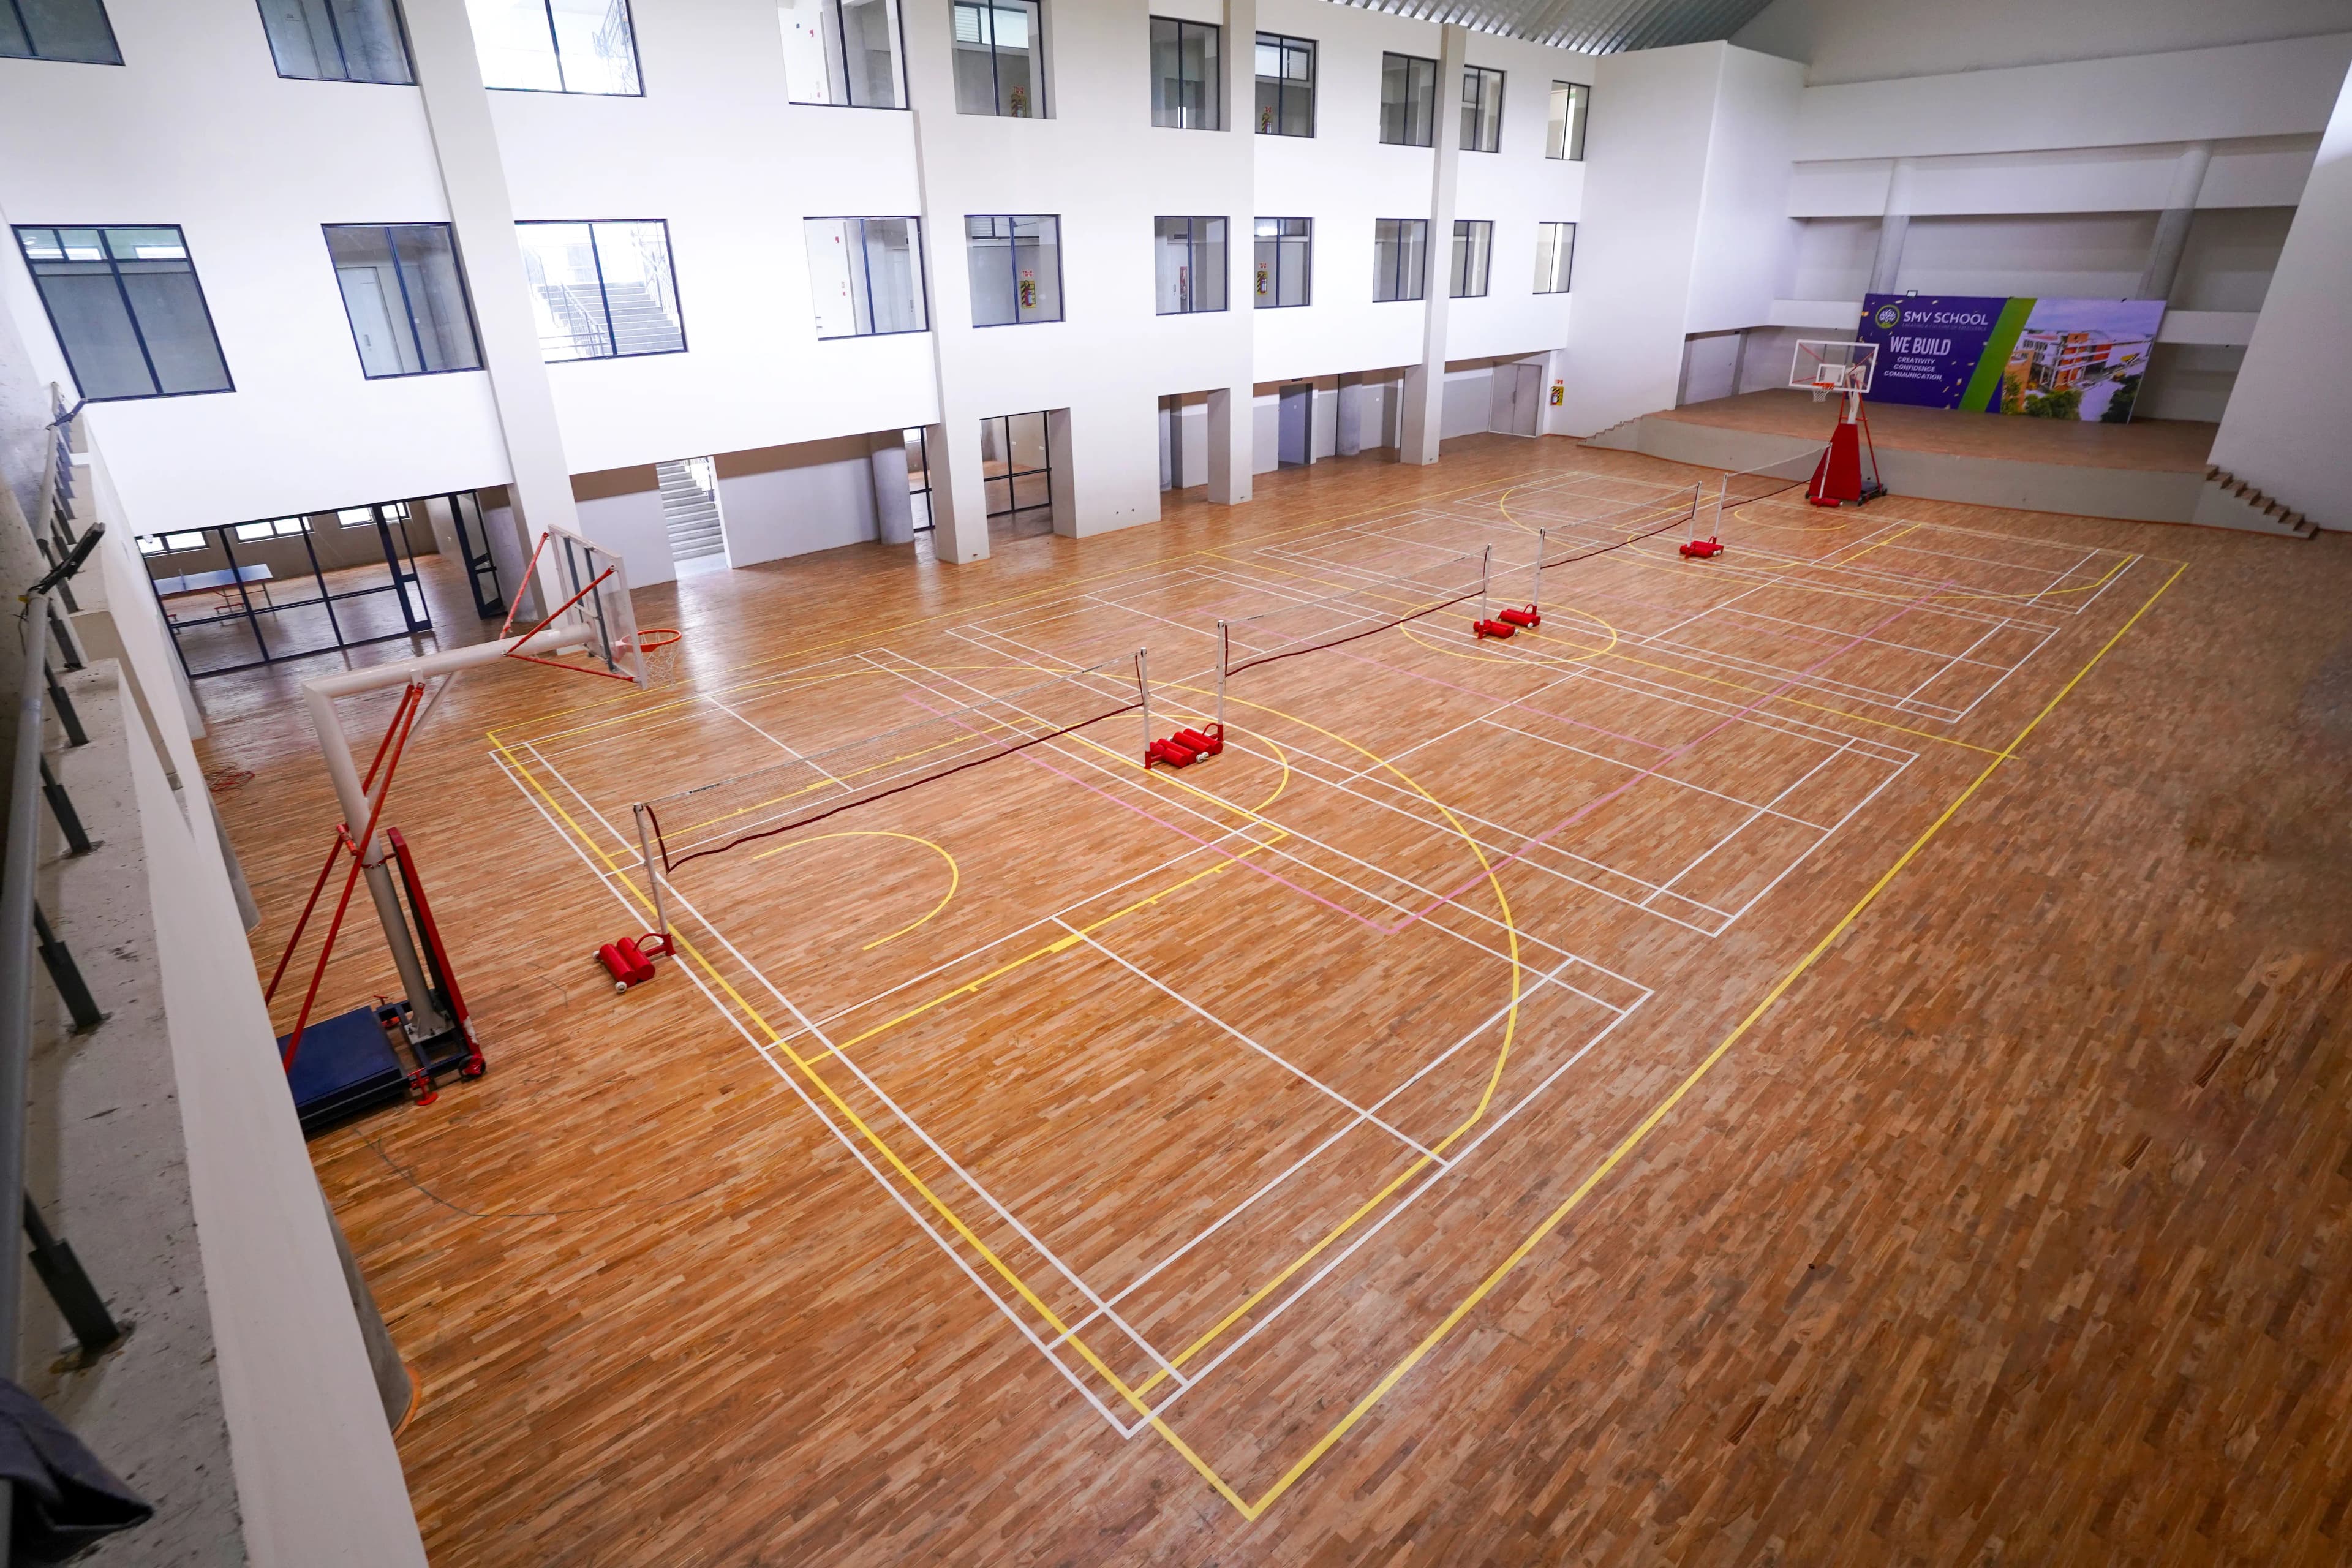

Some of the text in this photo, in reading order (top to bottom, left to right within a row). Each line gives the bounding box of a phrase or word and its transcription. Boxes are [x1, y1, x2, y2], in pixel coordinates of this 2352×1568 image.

[1903, 311, 1989, 325] SMV SCHOOL
[1890, 336, 1951, 355] WE BUILD
[1893, 364, 1936, 372] CONFIDENCE
